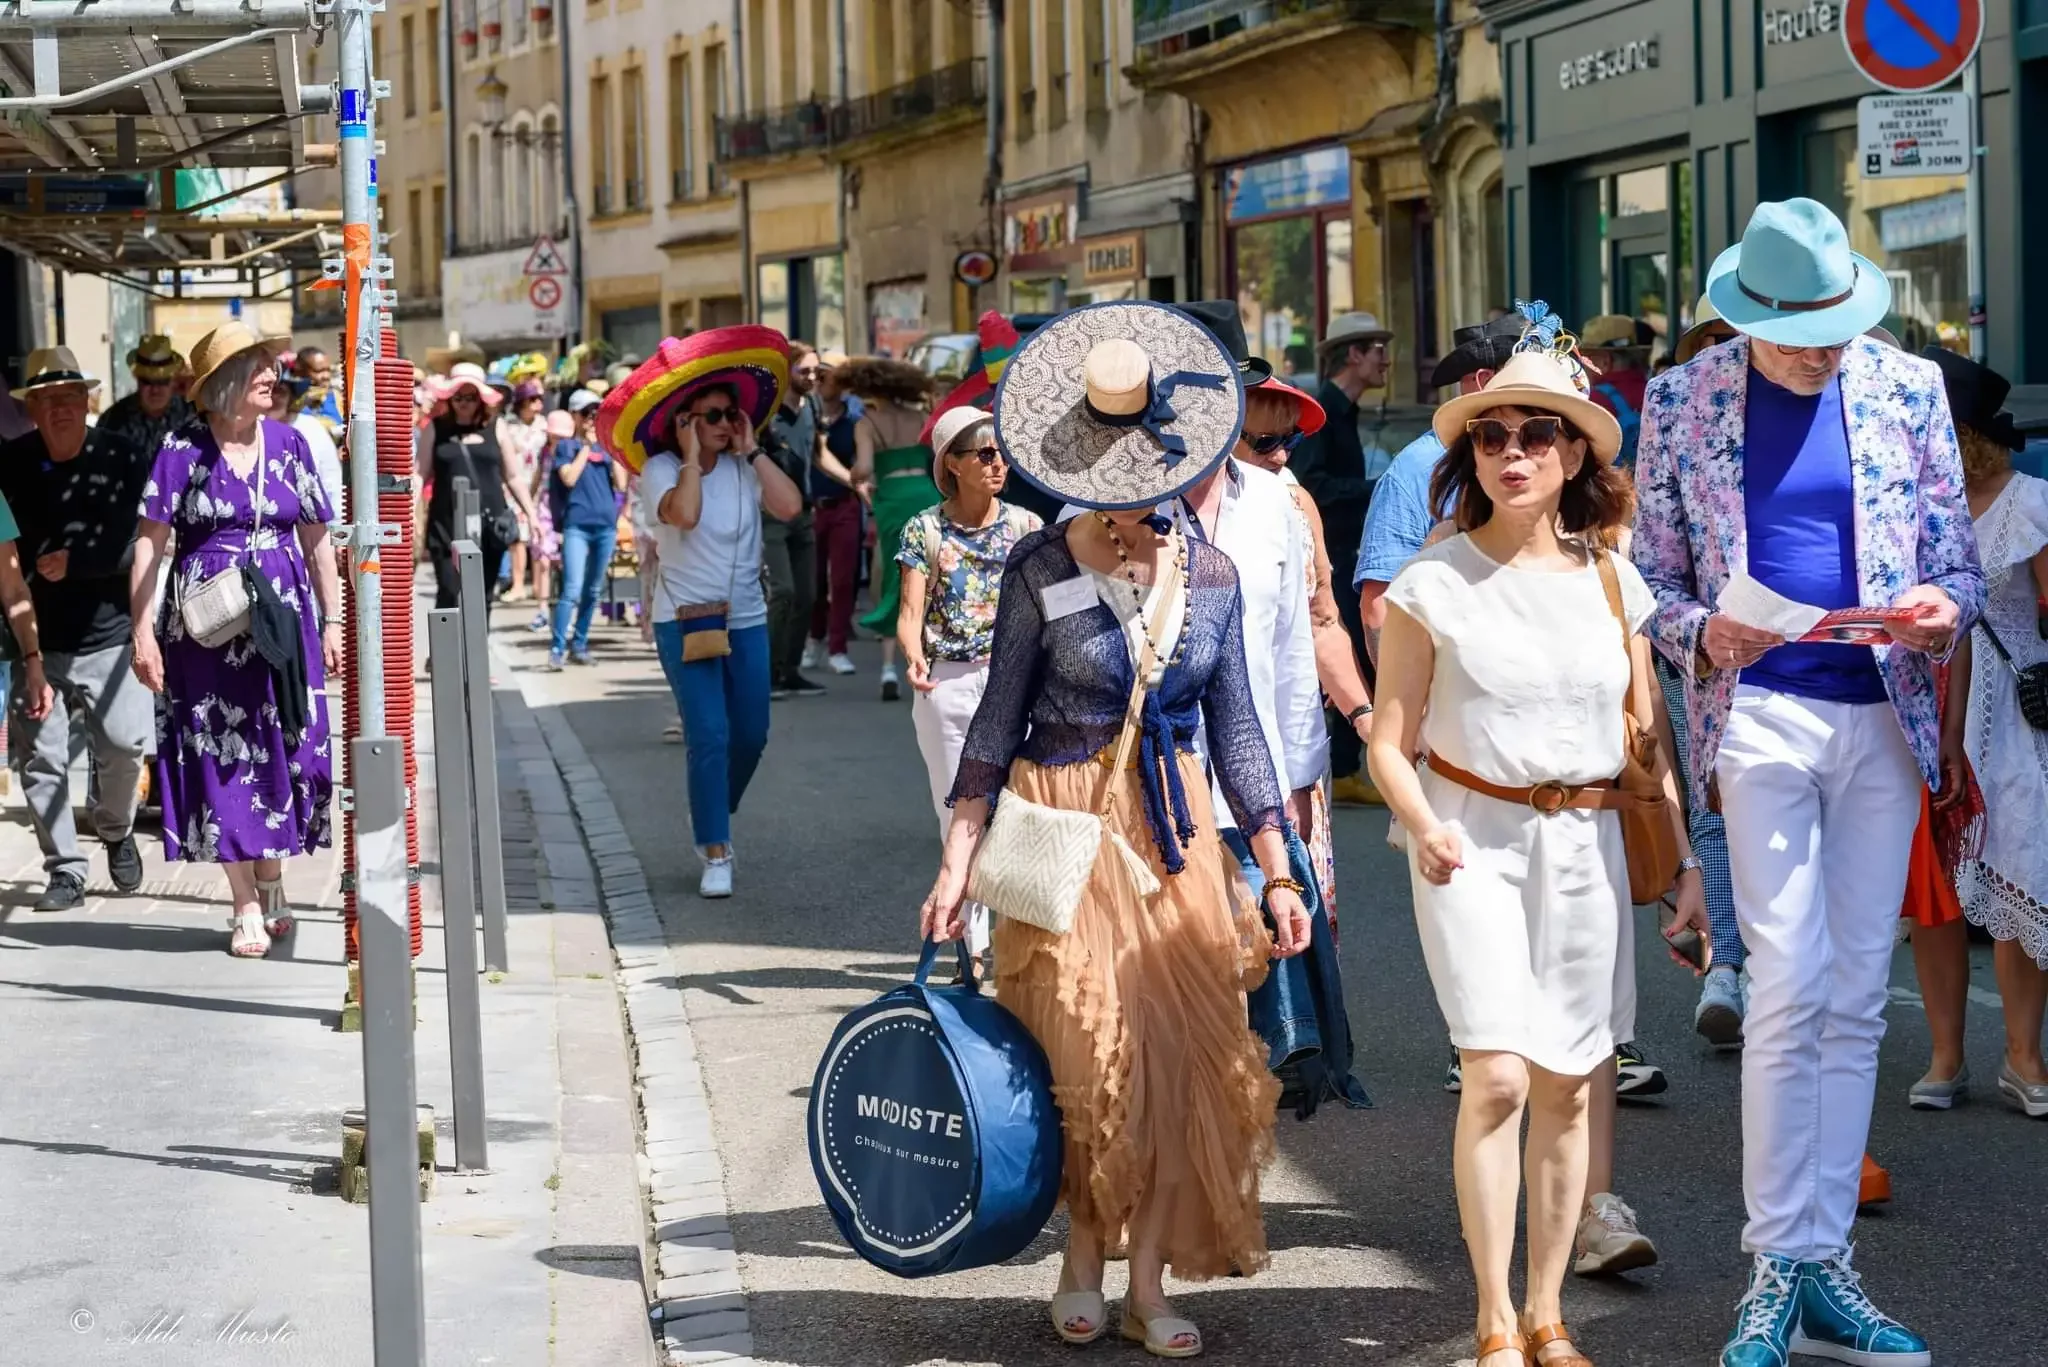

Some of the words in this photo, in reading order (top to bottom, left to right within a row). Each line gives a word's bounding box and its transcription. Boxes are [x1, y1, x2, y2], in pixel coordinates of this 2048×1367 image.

[1762, 0, 1832, 46] Haute
[1873, 97, 1954, 109] STATIONNEMENT
[1879, 120, 1900, 130] AIRE
[1883, 130, 1944, 140] LIVRAISONS
[857, 1094, 963, 1138] MODISTE
[896, 1147, 909, 1160] sur
[913, 1152, 960, 1169] mesure
